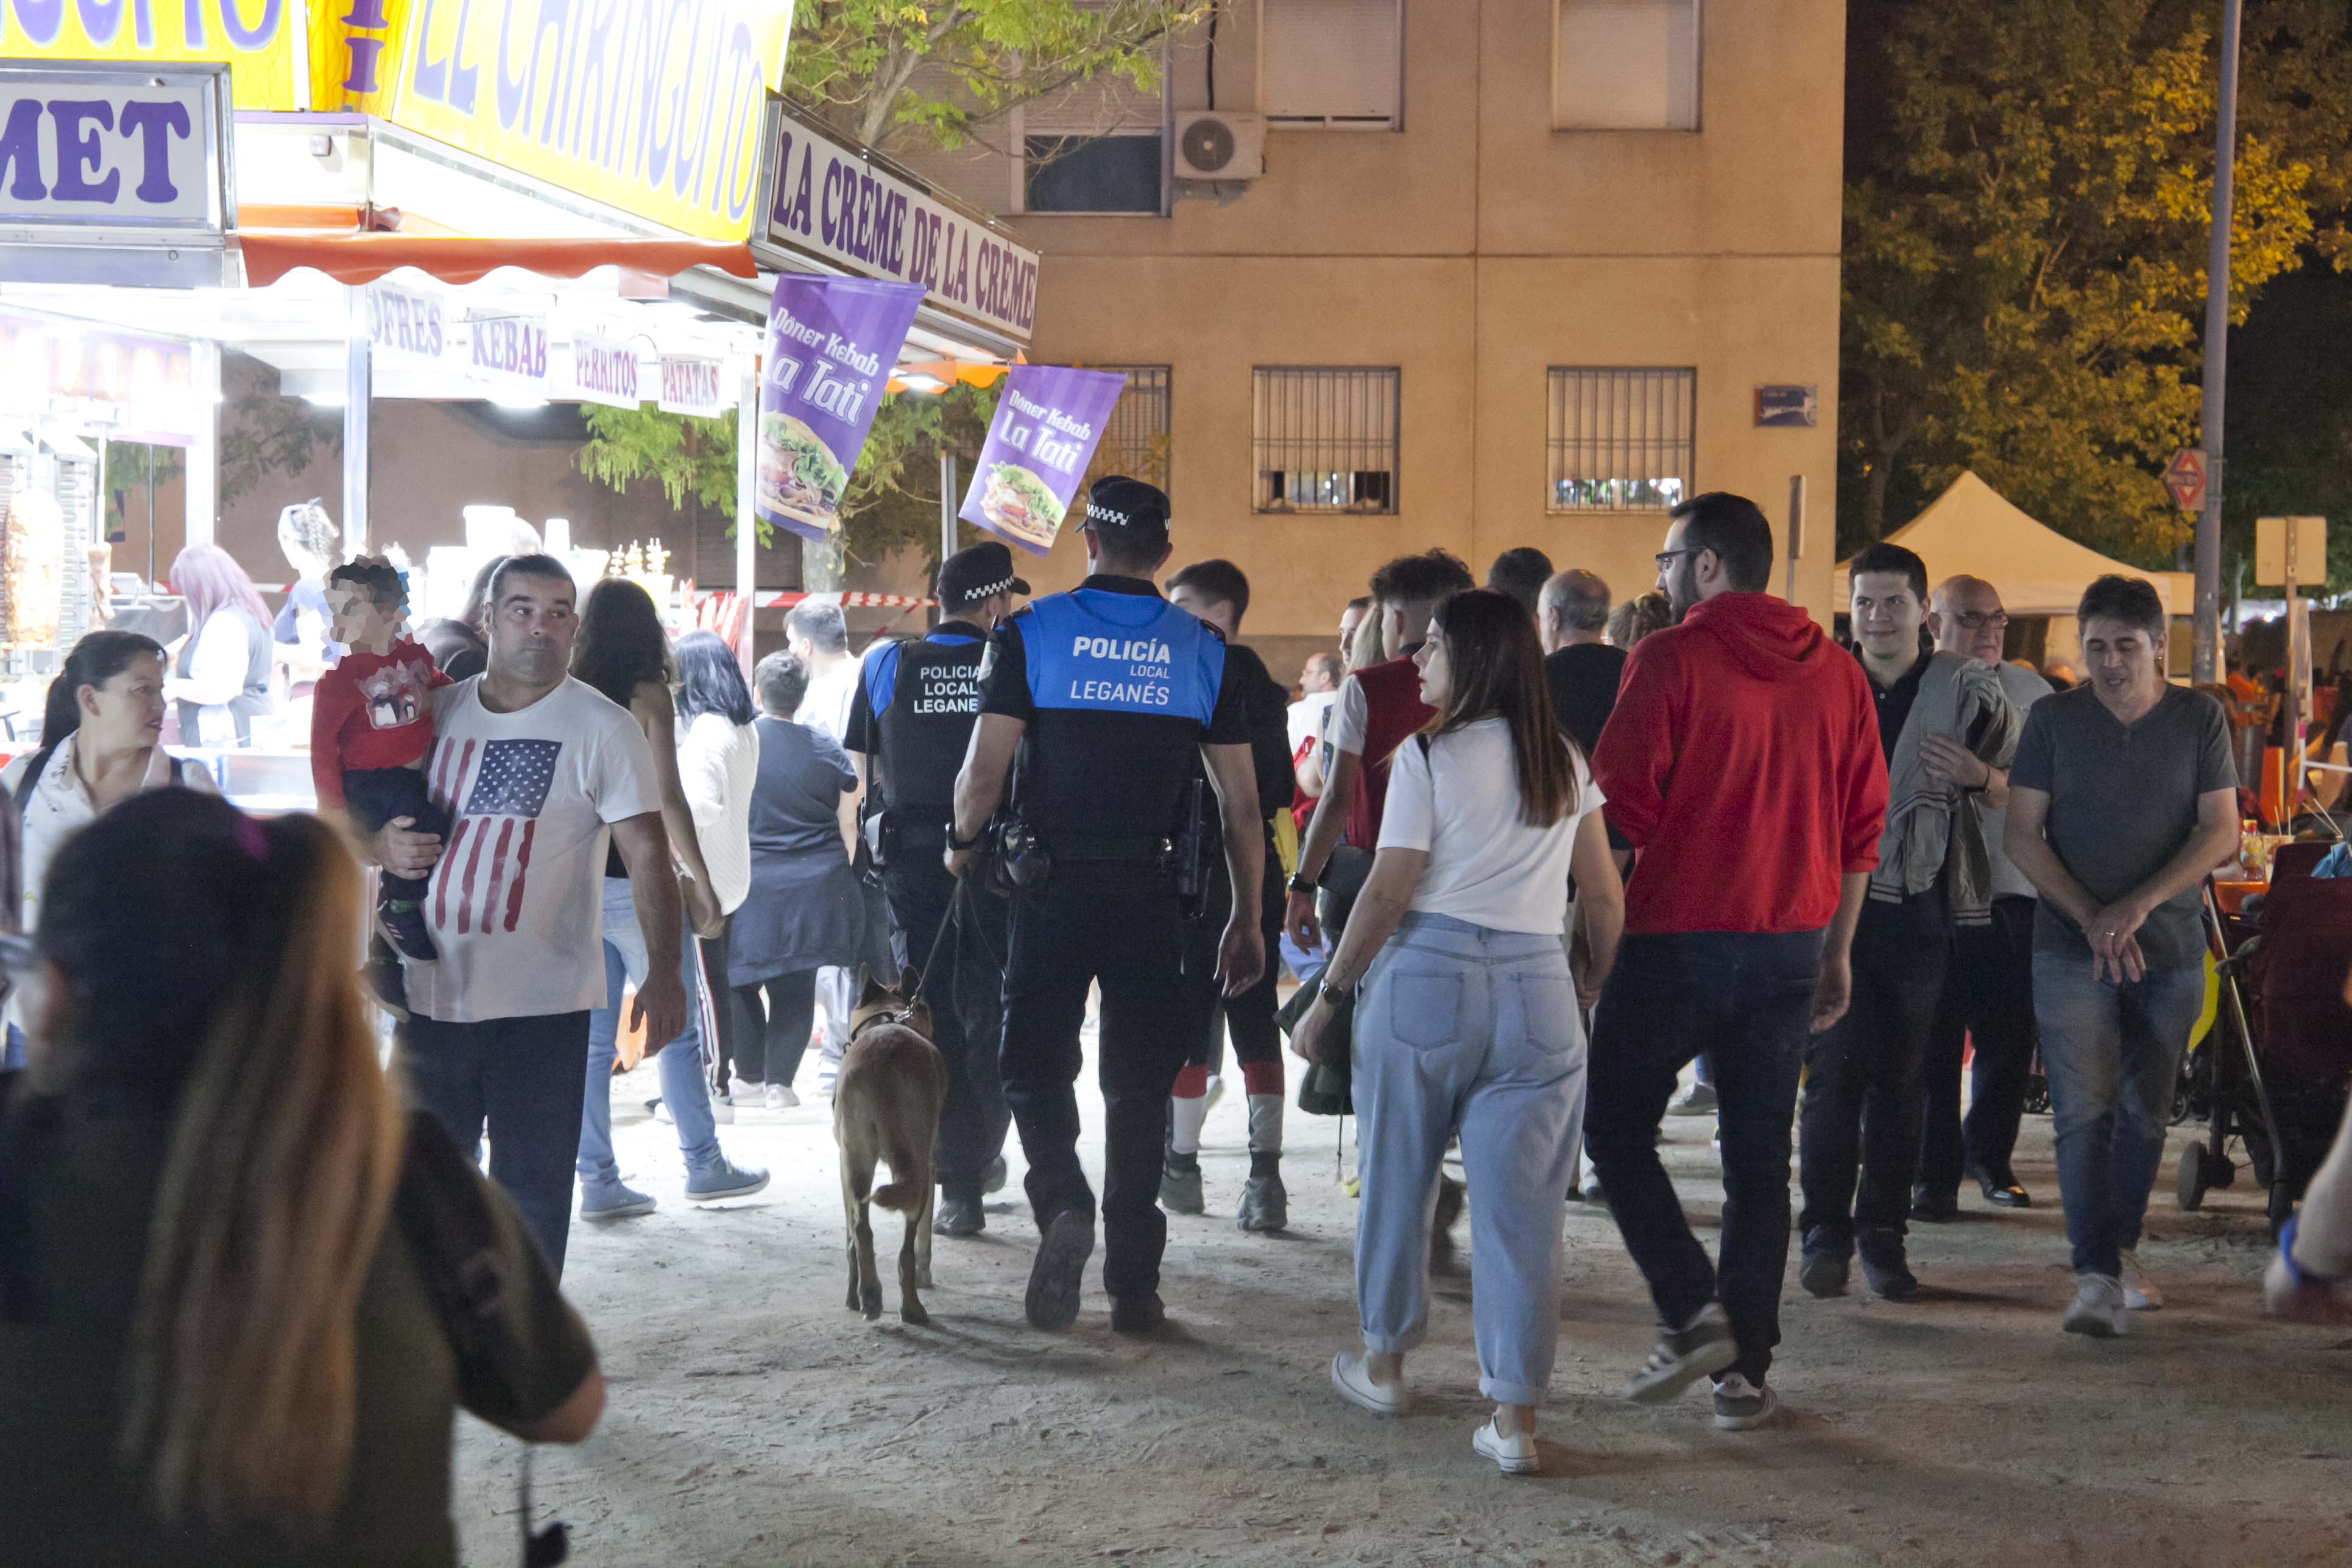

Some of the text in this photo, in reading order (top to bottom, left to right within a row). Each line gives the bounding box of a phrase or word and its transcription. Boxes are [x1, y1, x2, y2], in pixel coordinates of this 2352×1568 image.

[773, 131, 811, 236] LA
[821, 164, 907, 277] CRÈME
[909, 207, 942, 292] DE
[942, 222, 968, 304] LA
[471, 317, 546, 379] KEBAB
[775, 306, 880, 378] Döner Kebab
[575, 339, 638, 398] PERRITOS
[661, 357, 718, 407] PATATAS
[802, 358, 869, 425] Tati
[1000, 410, 1082, 473] La Tati
[1046, 408, 1091, 441] Kebab
[1072, 636, 1171, 665] POLICÍA
[1130, 664, 1170, 679] LOCAL
[914, 697, 978, 713] LEGANE
[924, 681, 978, 696] LOCAL
[1070, 680, 1170, 705] LEGANÉS
